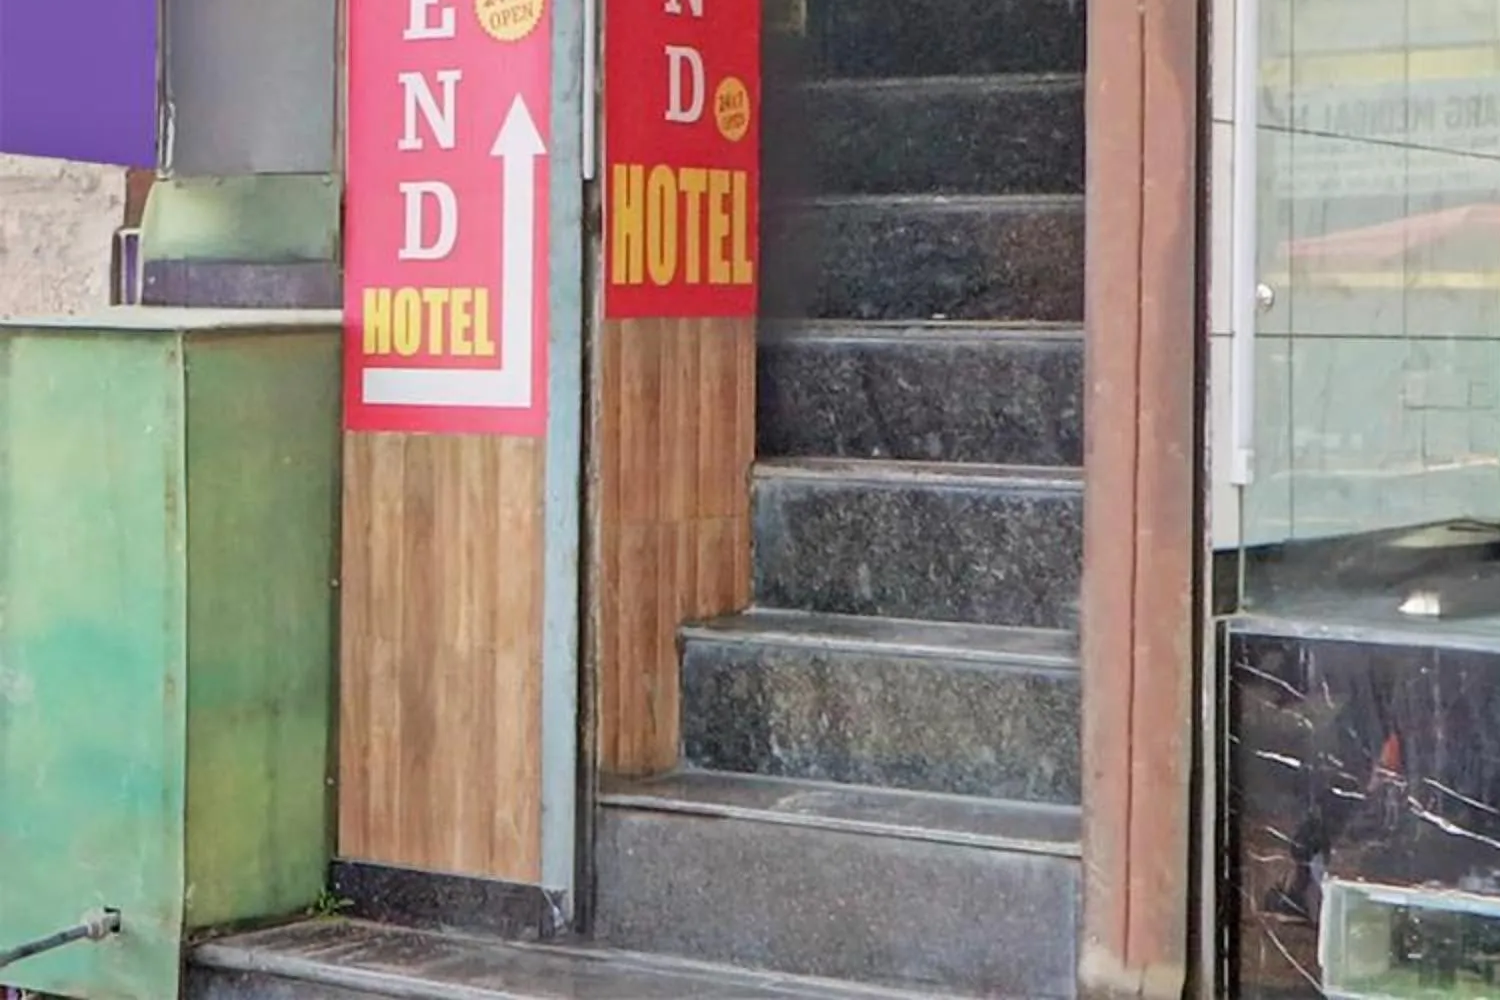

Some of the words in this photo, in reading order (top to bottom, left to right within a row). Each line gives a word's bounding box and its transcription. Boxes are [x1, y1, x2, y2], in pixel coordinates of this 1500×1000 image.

[489, 0, 534, 30] OPEN
[611, 163, 753, 286] HOTEL
[362, 286, 495, 357] HOTEL
